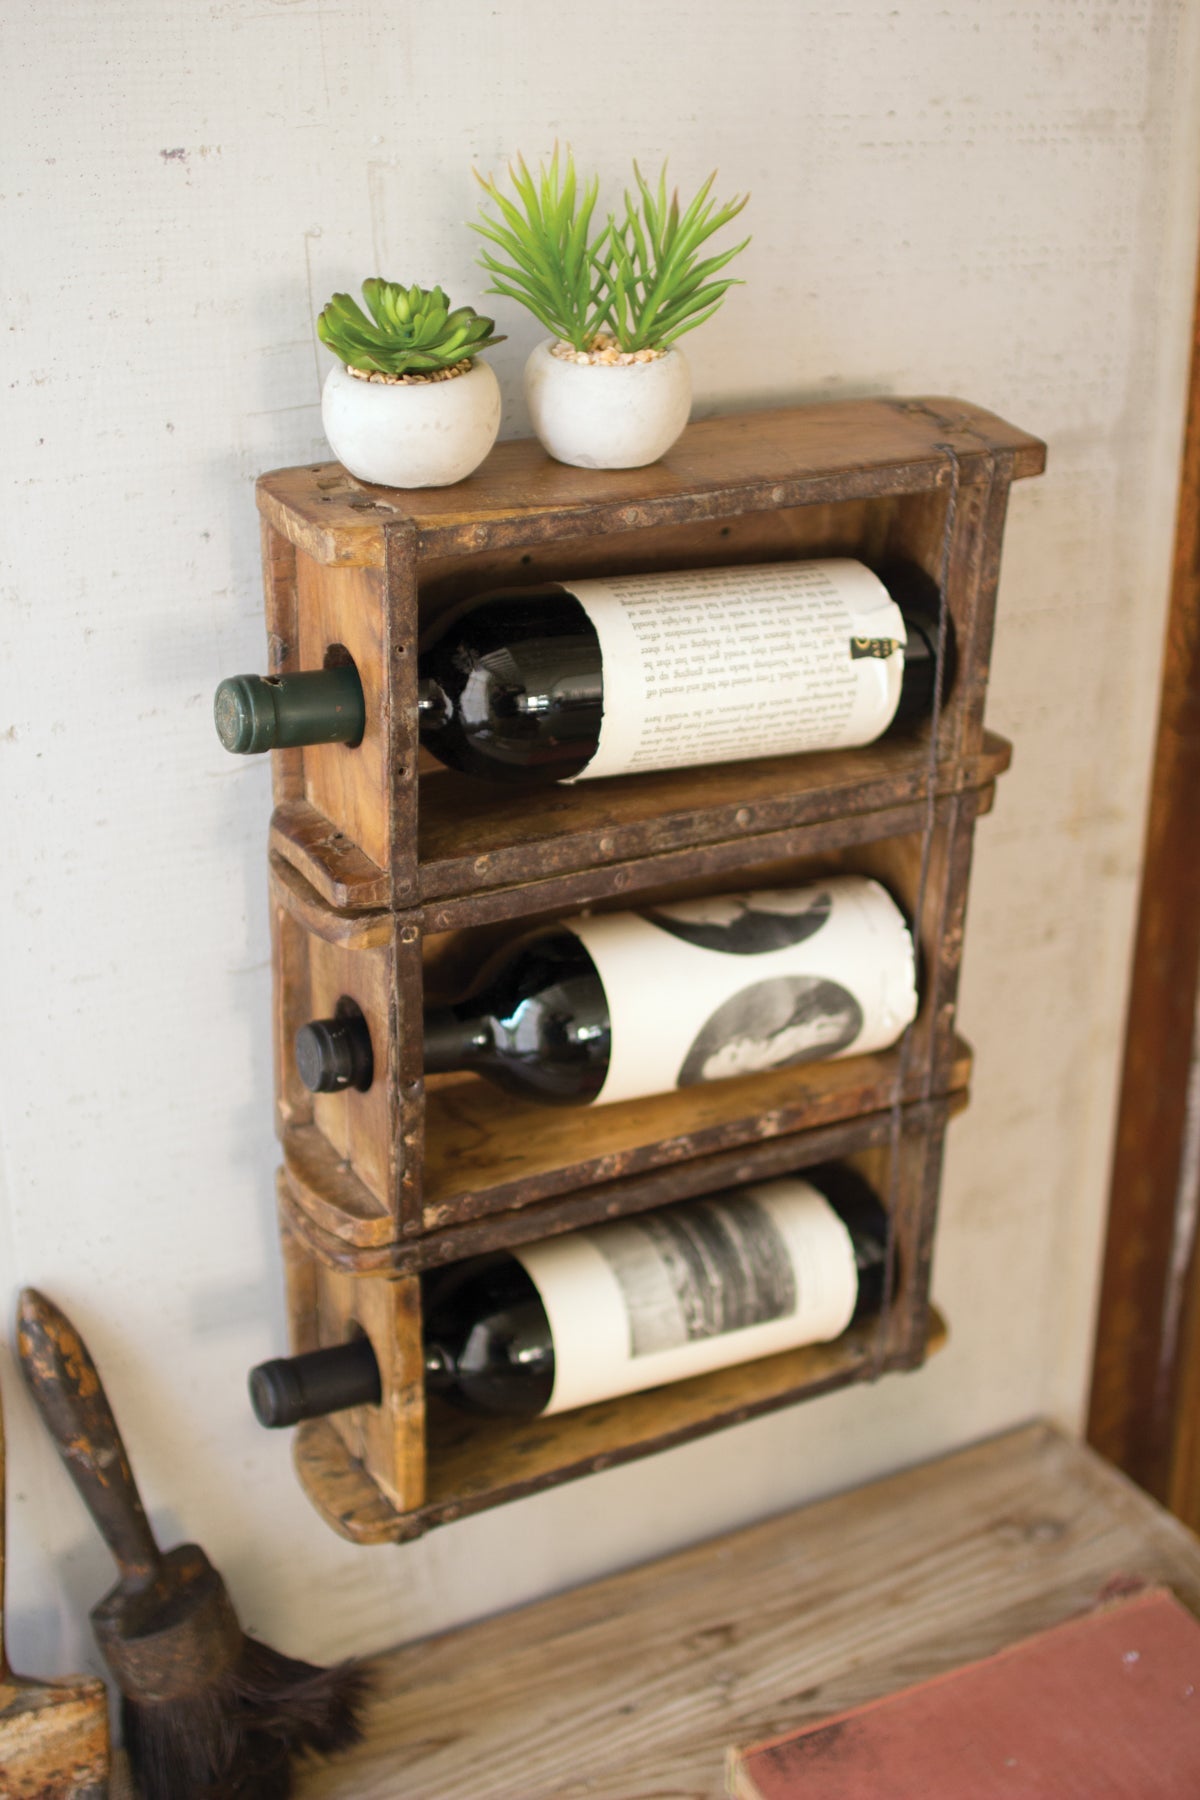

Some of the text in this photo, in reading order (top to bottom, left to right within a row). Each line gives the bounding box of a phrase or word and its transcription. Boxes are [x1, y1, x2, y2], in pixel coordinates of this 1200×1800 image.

[631, 620, 657, 629] should
[661, 614, 691, 626] daylight
[635, 632, 660, 643] effort,
[725, 634, 736, 646] by
[664, 641, 675, 653] by
[691, 655, 705, 664] him
[723, 650, 746, 660] would
[643, 661, 652, 670] he
[656, 659, 671, 669] that
[658, 670, 668, 680] up
[755, 671, 774, 683] Tony
[659, 685, 684, 696] started
[685, 683, 700, 692] and
[701, 681, 715, 690] ball
[644, 689, 657, 698] off
[644, 715, 661, 724] have
[664, 712, 688, 722] would
